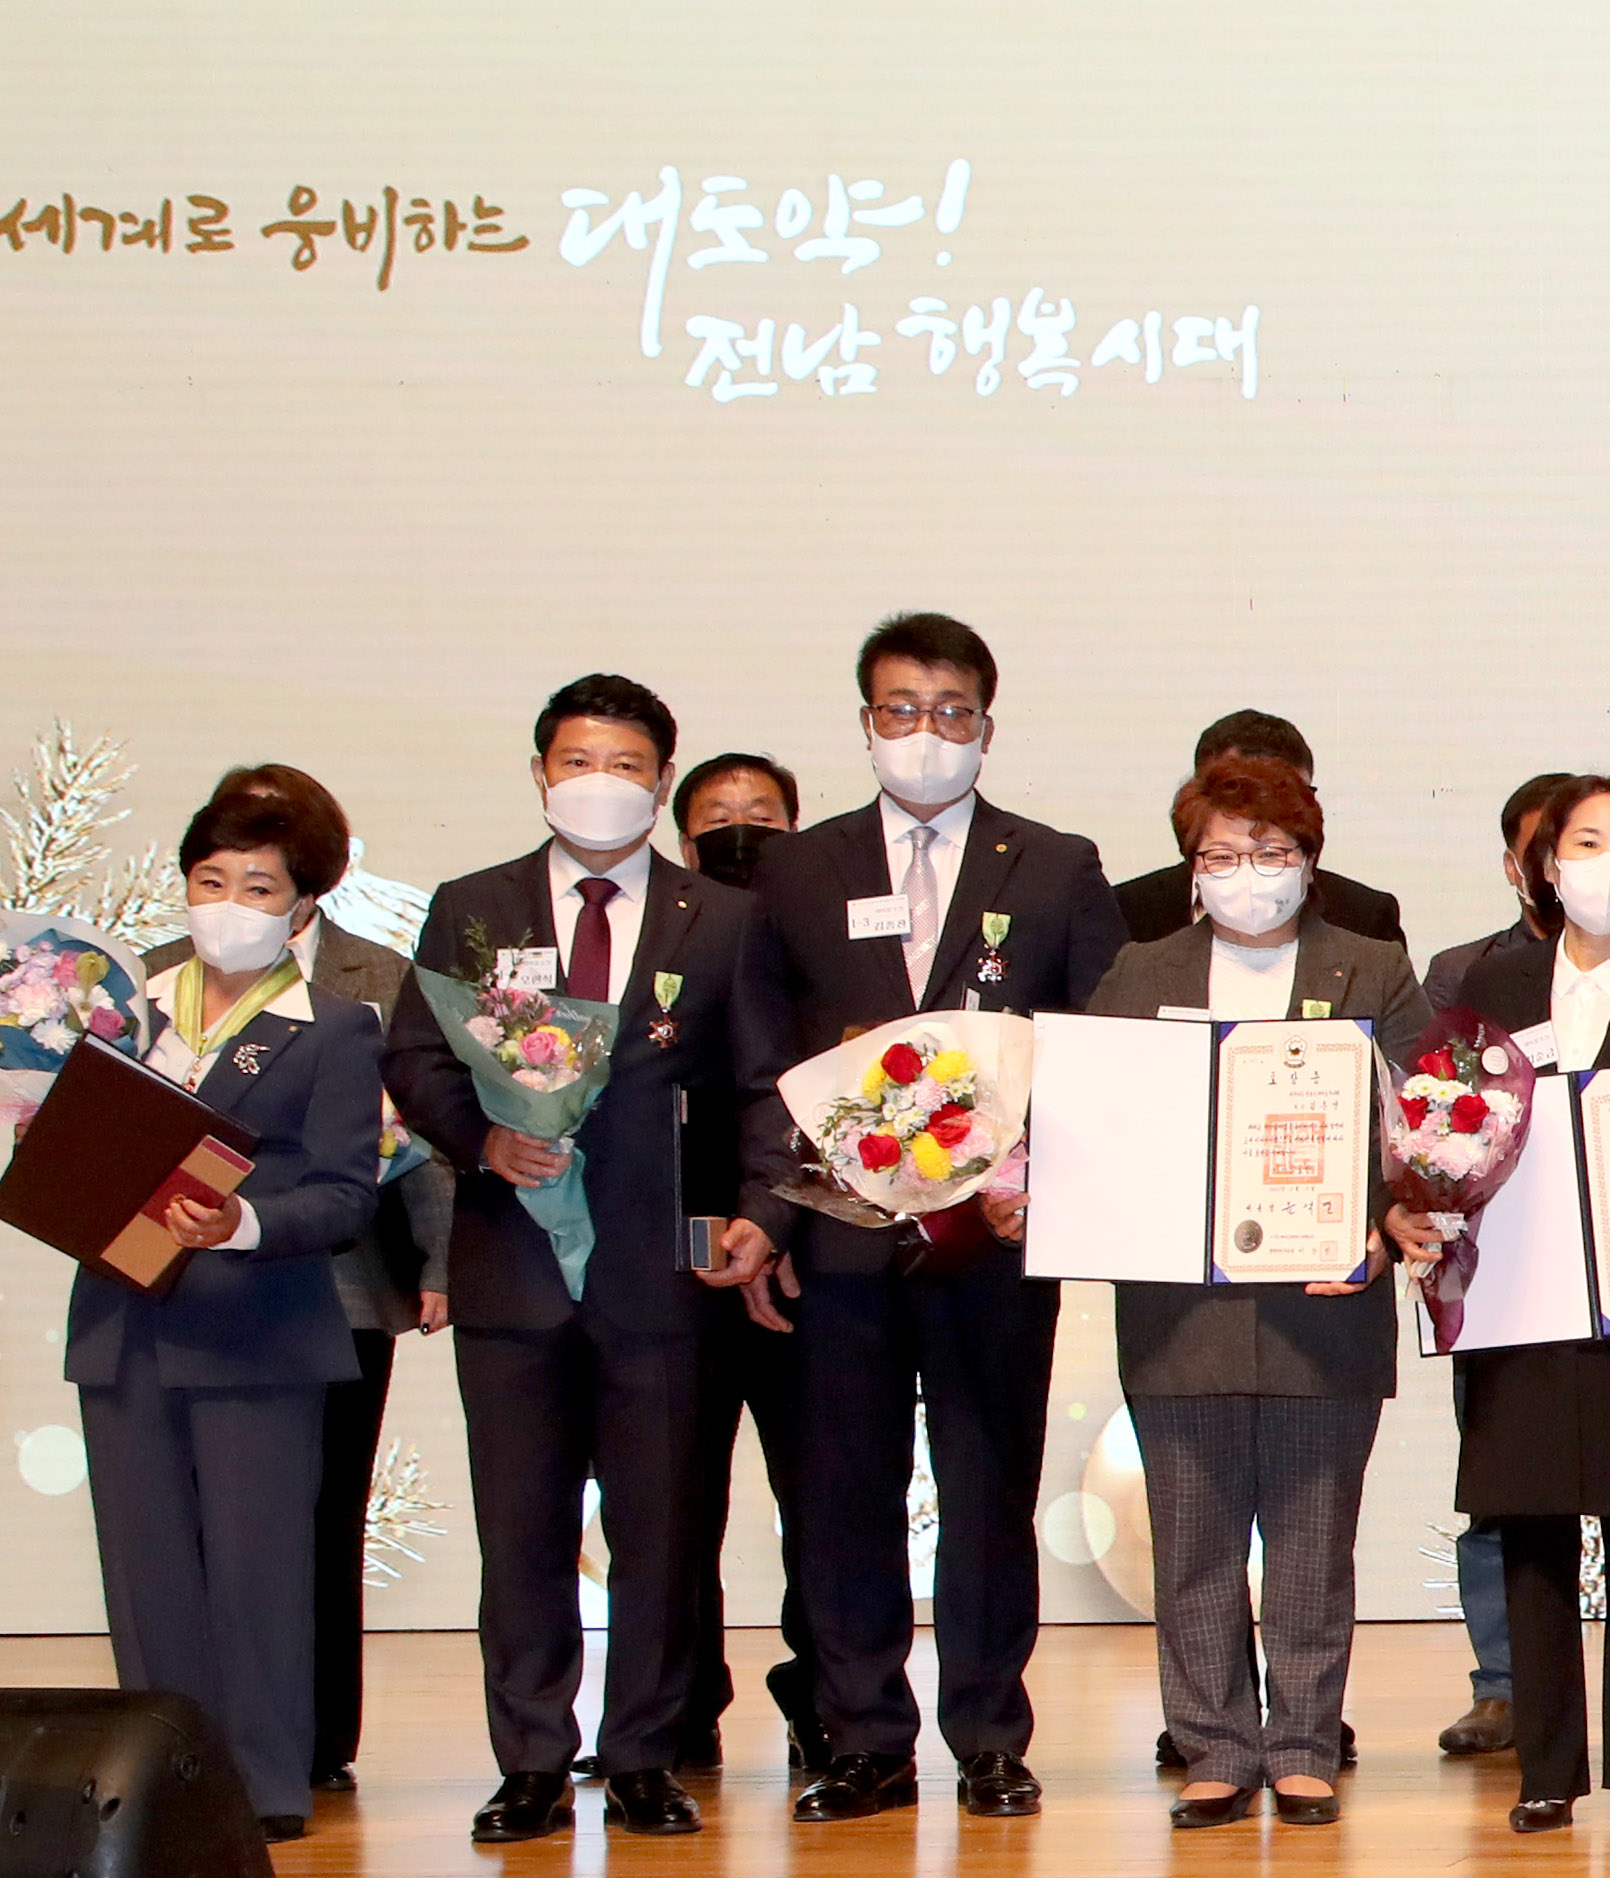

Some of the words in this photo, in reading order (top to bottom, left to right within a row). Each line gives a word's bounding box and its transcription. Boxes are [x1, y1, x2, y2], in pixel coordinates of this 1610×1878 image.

[0, 194, 236, 256] 세계로
[262, 187, 530, 292] 웅비하는
[559, 158, 972, 358] 대도약!
[685, 303, 882, 403] 전남
